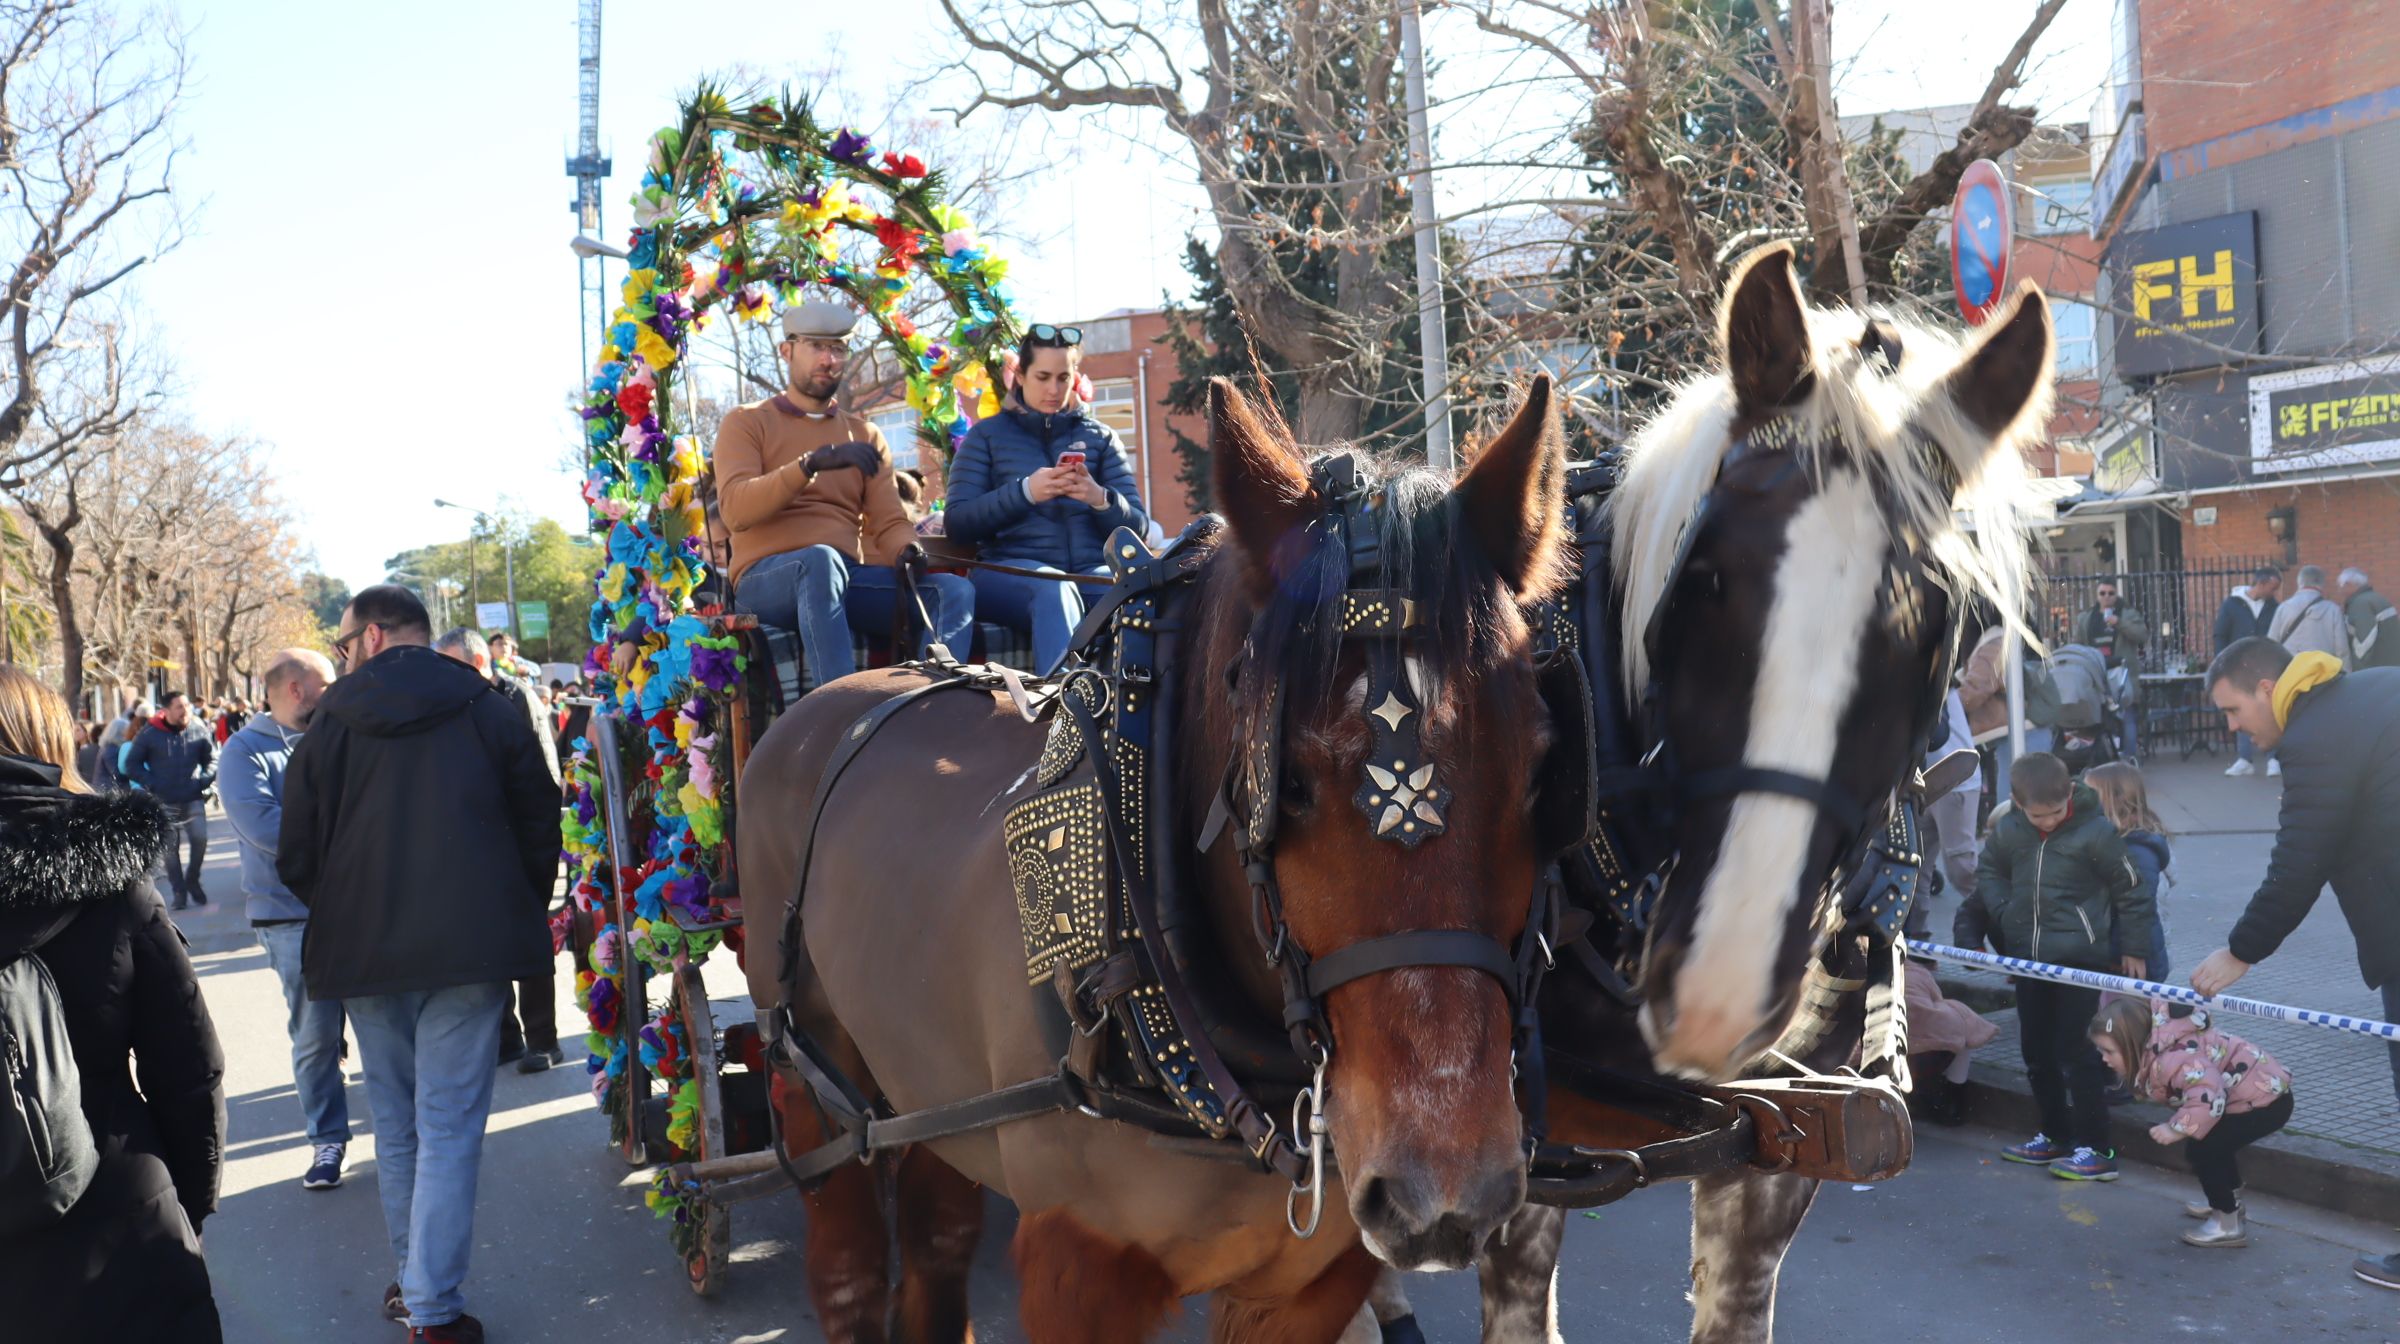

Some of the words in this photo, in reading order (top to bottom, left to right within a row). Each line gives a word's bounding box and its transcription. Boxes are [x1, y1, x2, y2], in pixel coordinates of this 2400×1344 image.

[2132, 249, 2234, 321] FH
[2072, 970, 2100, 986] POLICIA
[2102, 975, 2124, 990] LOCAL
[2223, 998, 2256, 1015] POLICIA
[2260, 1004, 2286, 1020] LOCAL
